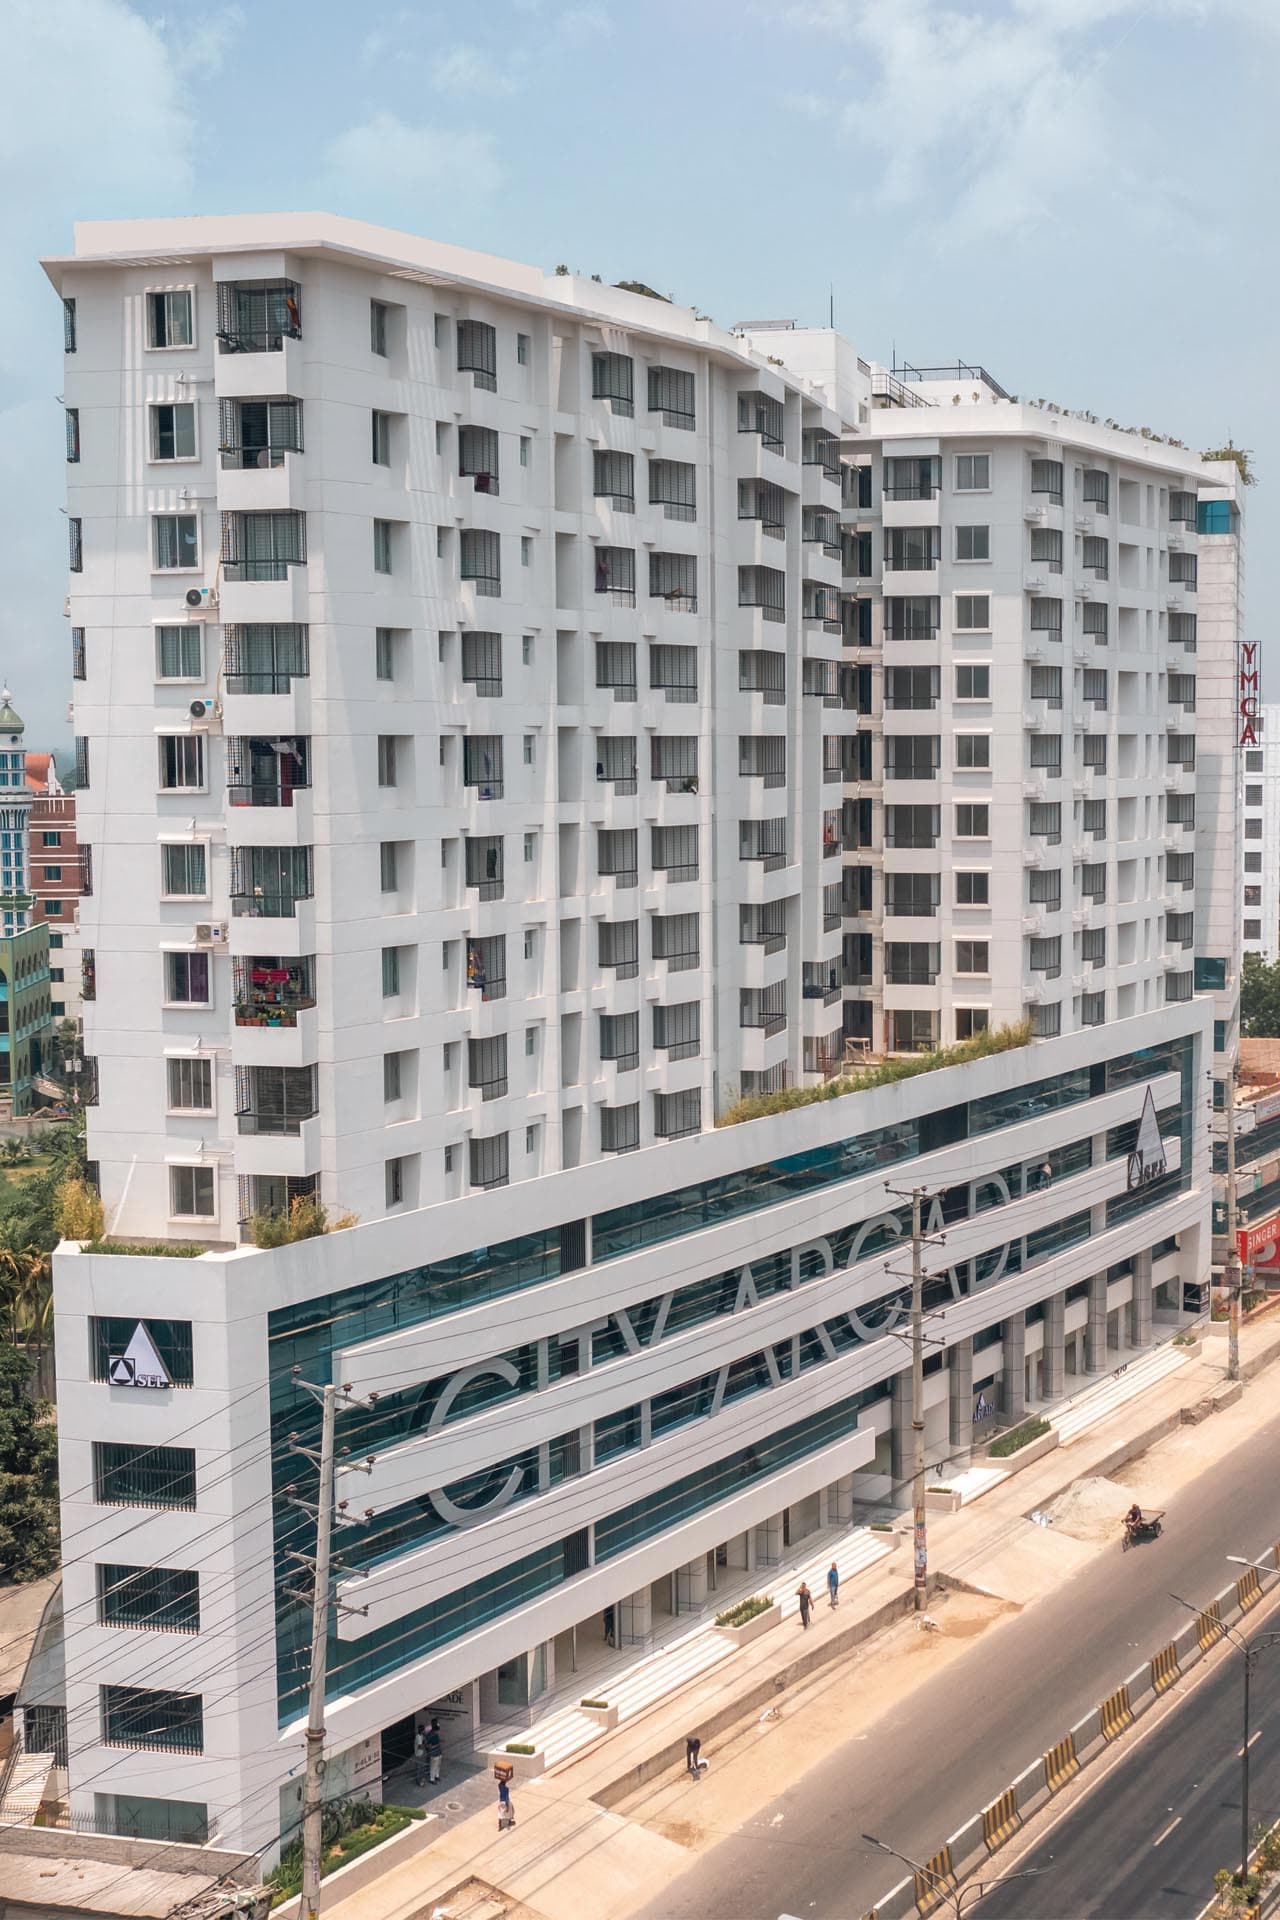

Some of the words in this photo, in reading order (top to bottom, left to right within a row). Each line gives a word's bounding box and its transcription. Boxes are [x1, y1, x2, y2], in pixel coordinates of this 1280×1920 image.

[1239, 643, 1259, 745] YMCA
[1247, 1223, 1277, 1250] SINGER
[137, 1374, 165, 1388] SEL
